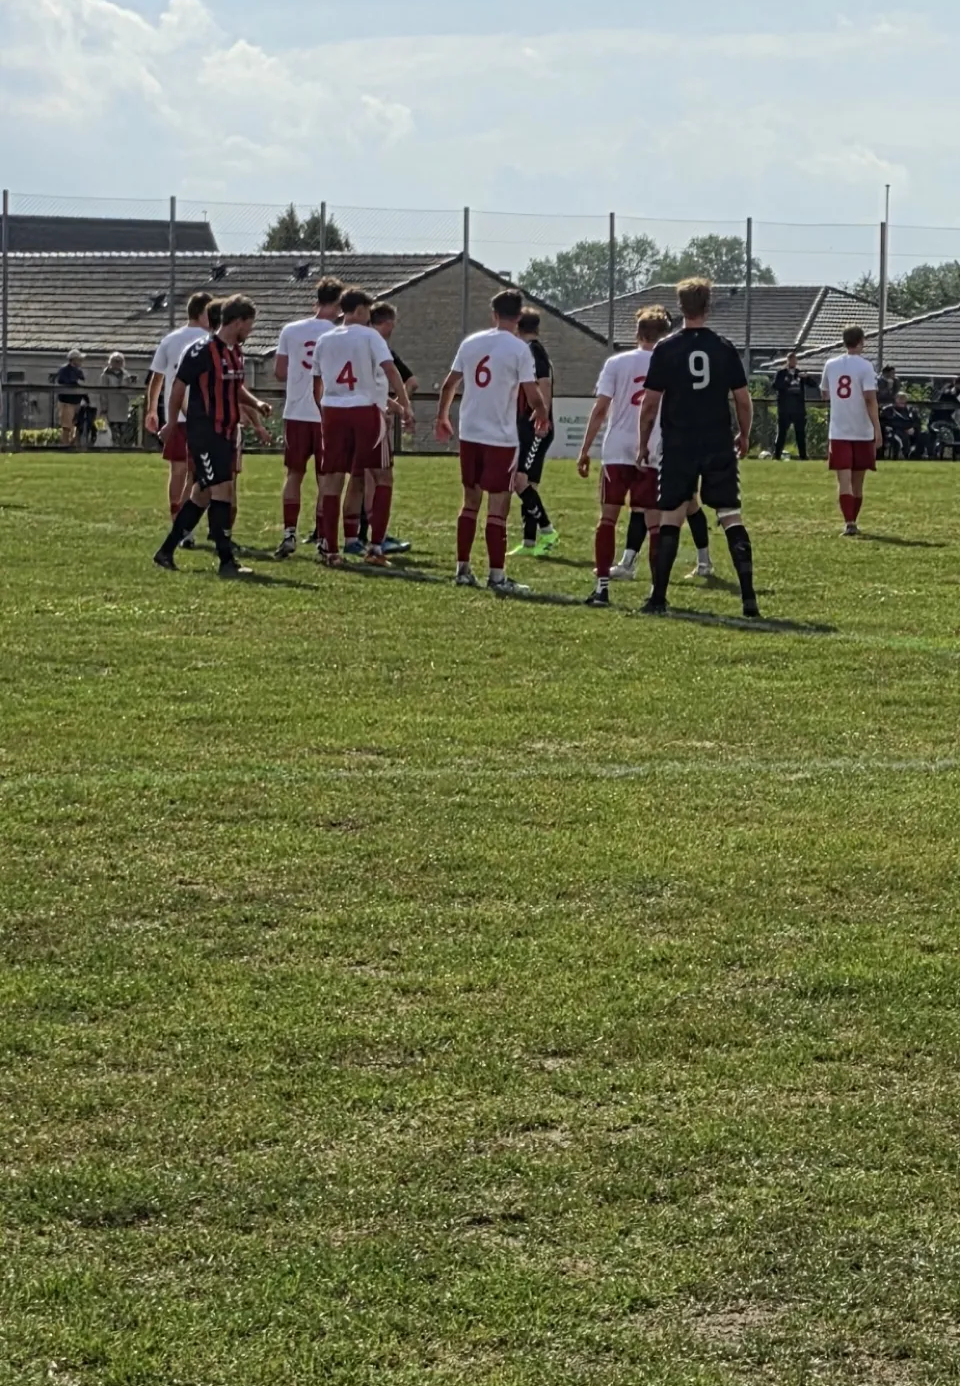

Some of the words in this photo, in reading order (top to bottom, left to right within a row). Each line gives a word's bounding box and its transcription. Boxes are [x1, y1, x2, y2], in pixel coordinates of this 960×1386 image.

[302, 341, 316, 369] 3
[688, 350, 710, 390] 9
[336, 361, 357, 391] 4
[475, 355, 491, 388] 6
[837, 375, 851, 399] 8
